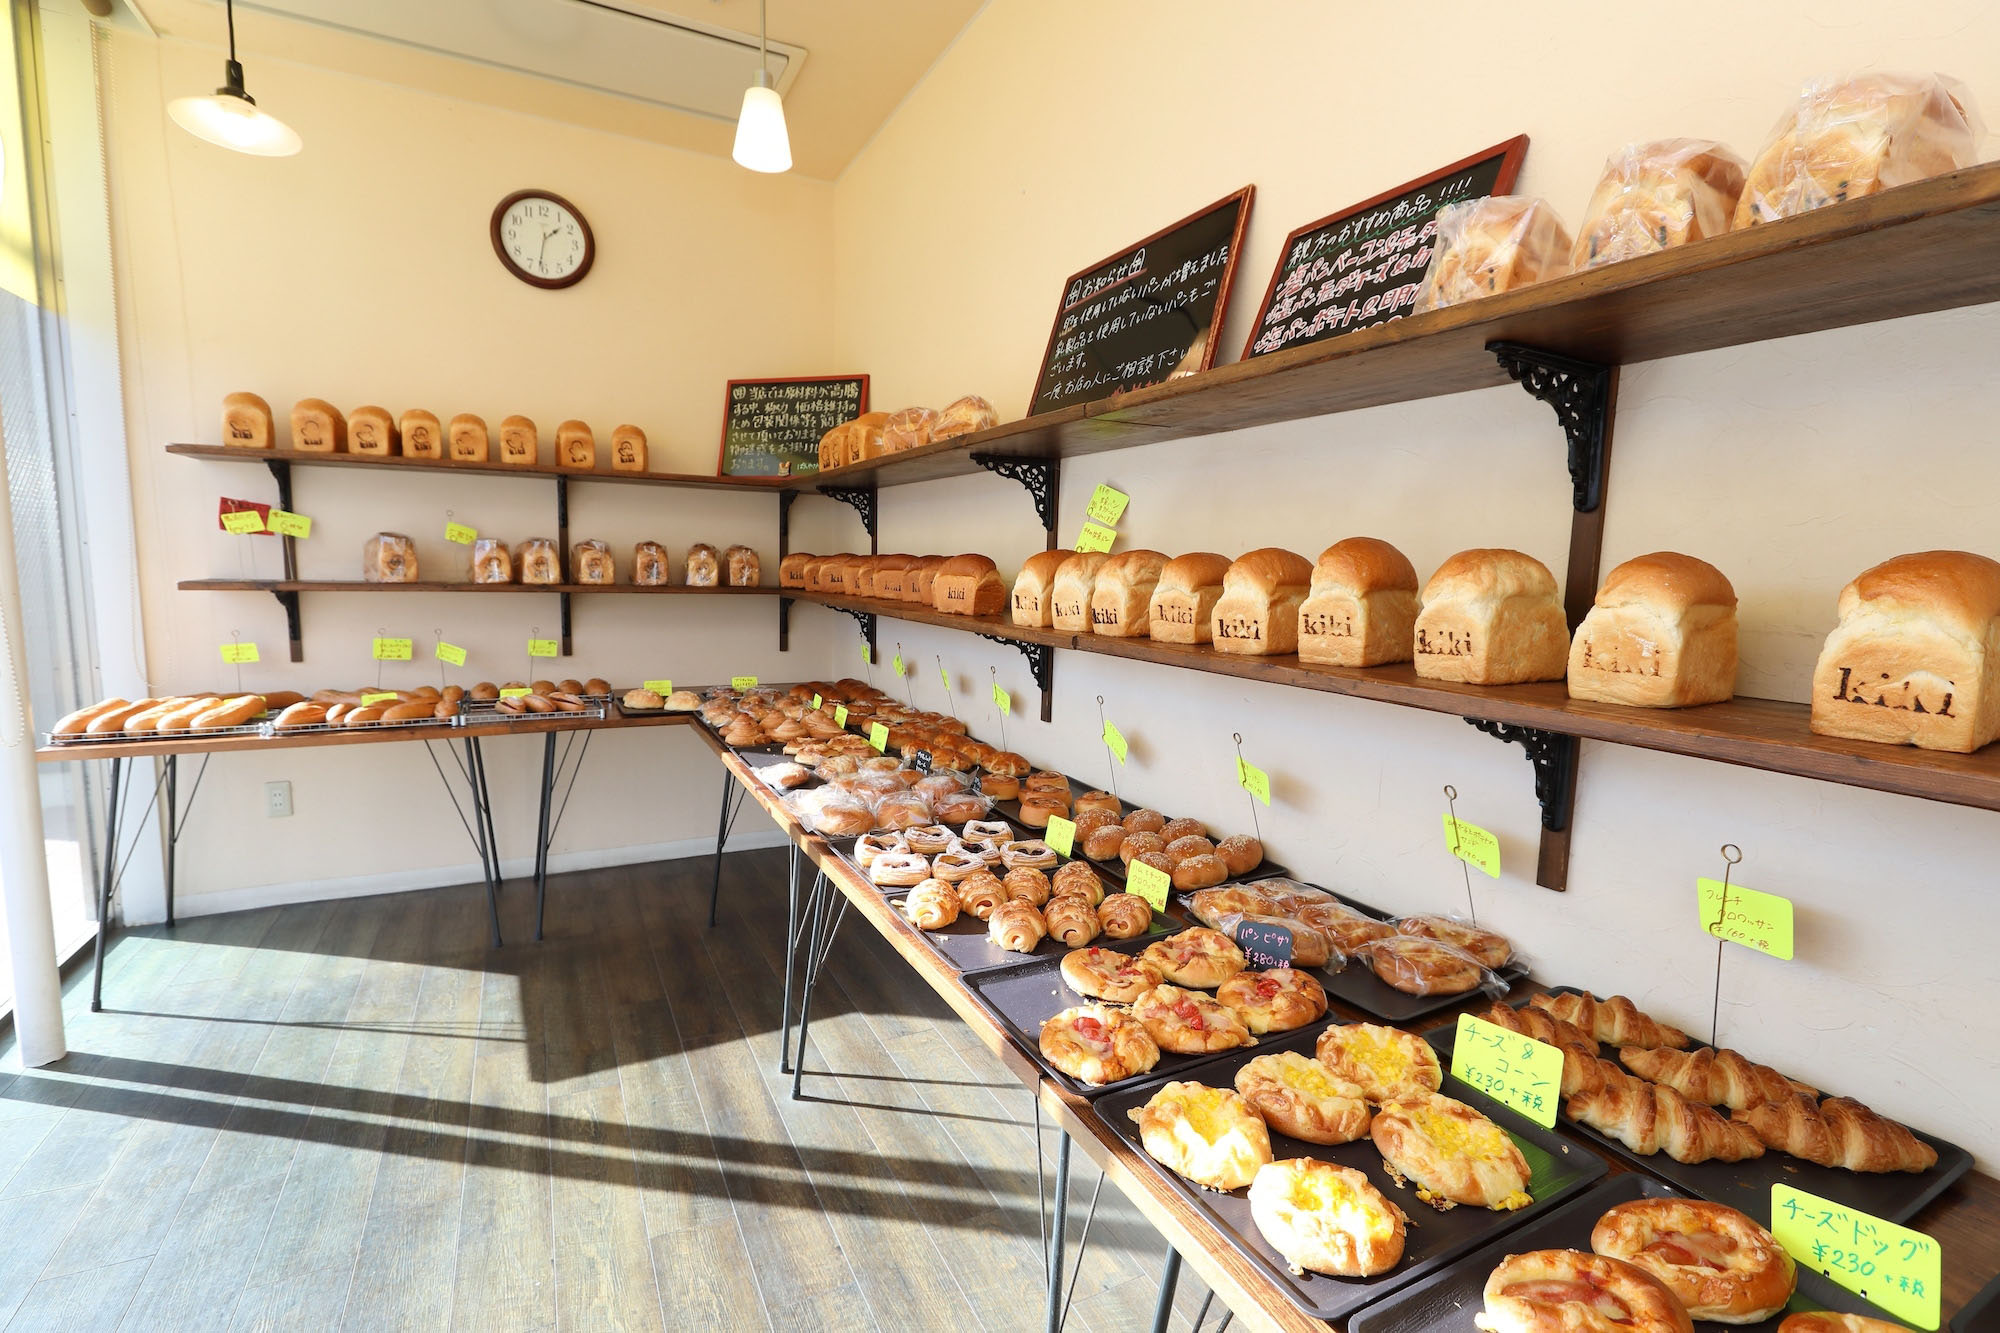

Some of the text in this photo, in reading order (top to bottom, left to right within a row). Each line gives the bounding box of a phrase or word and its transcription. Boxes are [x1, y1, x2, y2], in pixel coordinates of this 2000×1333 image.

[525, 205, 533, 218] 11
[539, 204, 549, 217] 12
[557, 211, 561, 223] 1
[512, 214, 522, 225] 10
[508, 229, 516, 240] 9
[567, 224, 574, 235] 2
[514, 245, 521, 255] 8
[572, 239, 579, 251] 3
[527, 257, 533, 269] 7
[567, 255, 573, 265] 4
[541, 263, 548, 274] 6
[556, 263, 563, 273] 5
[1082, 263, 1128, 299] お知らせ
[947, 587, 965, 600] kiki
[1055, 601, 1080, 617] kiki
[1158, 604, 1194, 624] kiki
[1091, 608, 1118, 625] kiki
[1218, 619, 1261, 640] kiki
[1302, 613, 1353, 637] kiki
[1416, 628, 1474, 657] kiki
[1718, 908, 1774, 930] クロワッサン
[1496, 1059, 1551, 1086] コーン
[1782, 1198, 1930, 1261] チーズドッグ
